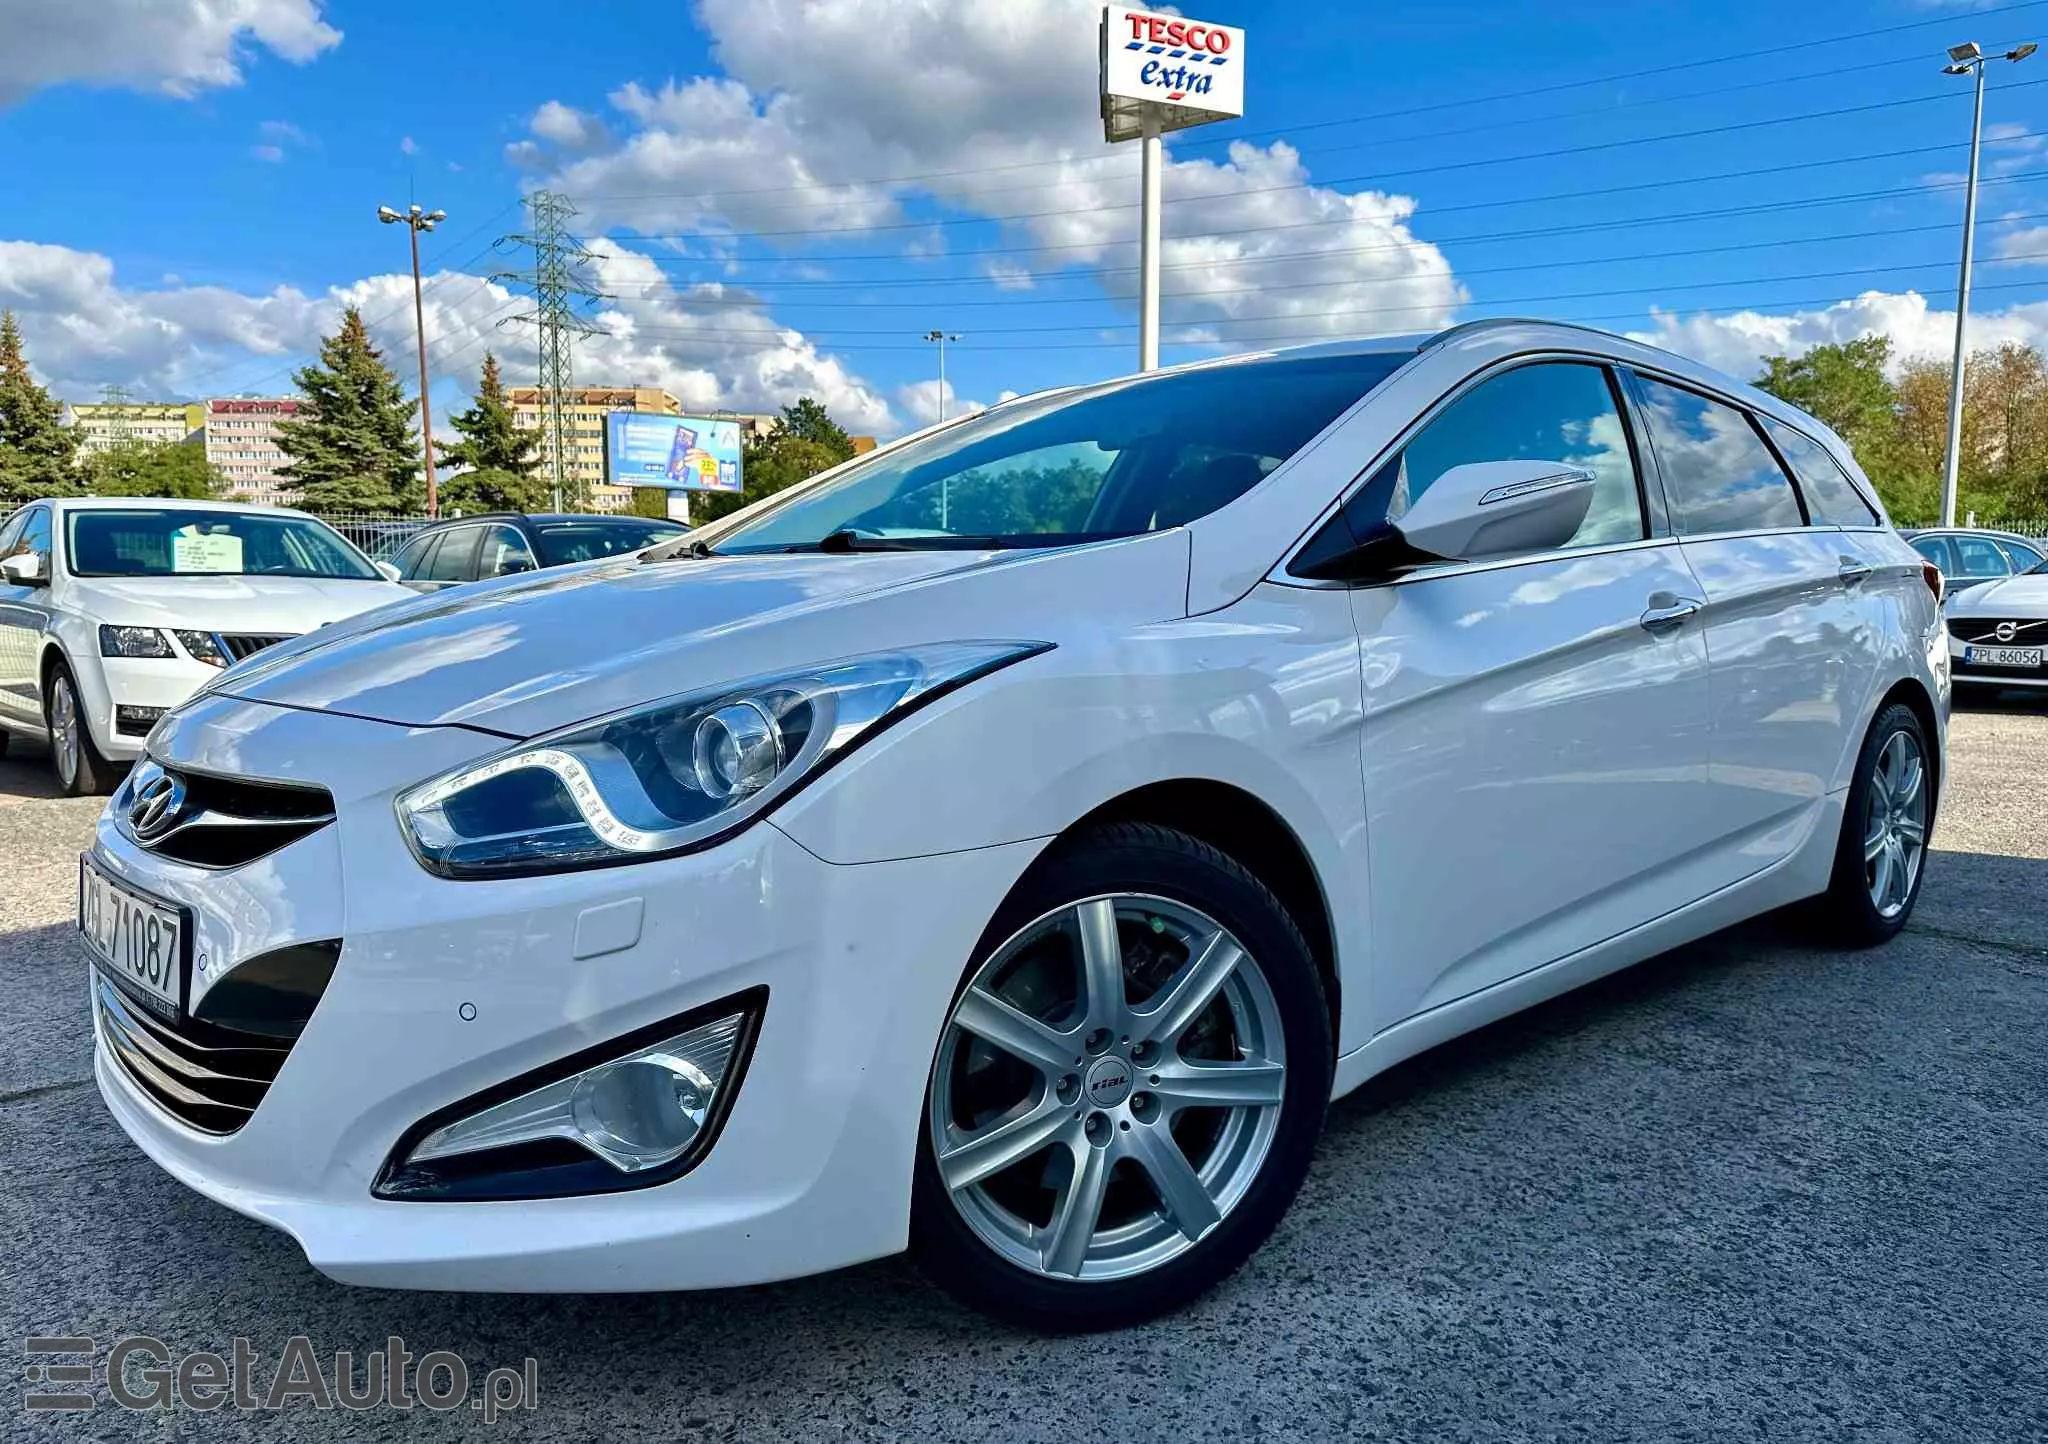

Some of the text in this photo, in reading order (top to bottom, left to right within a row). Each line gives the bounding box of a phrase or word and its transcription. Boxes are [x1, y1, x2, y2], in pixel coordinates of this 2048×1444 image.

[1125, 12, 1231, 54] TESCO
[1140, 60, 1213, 95] extra
[1973, 649, 2038, 664] ZPL 86056
[110, 891, 177, 993] 71087
